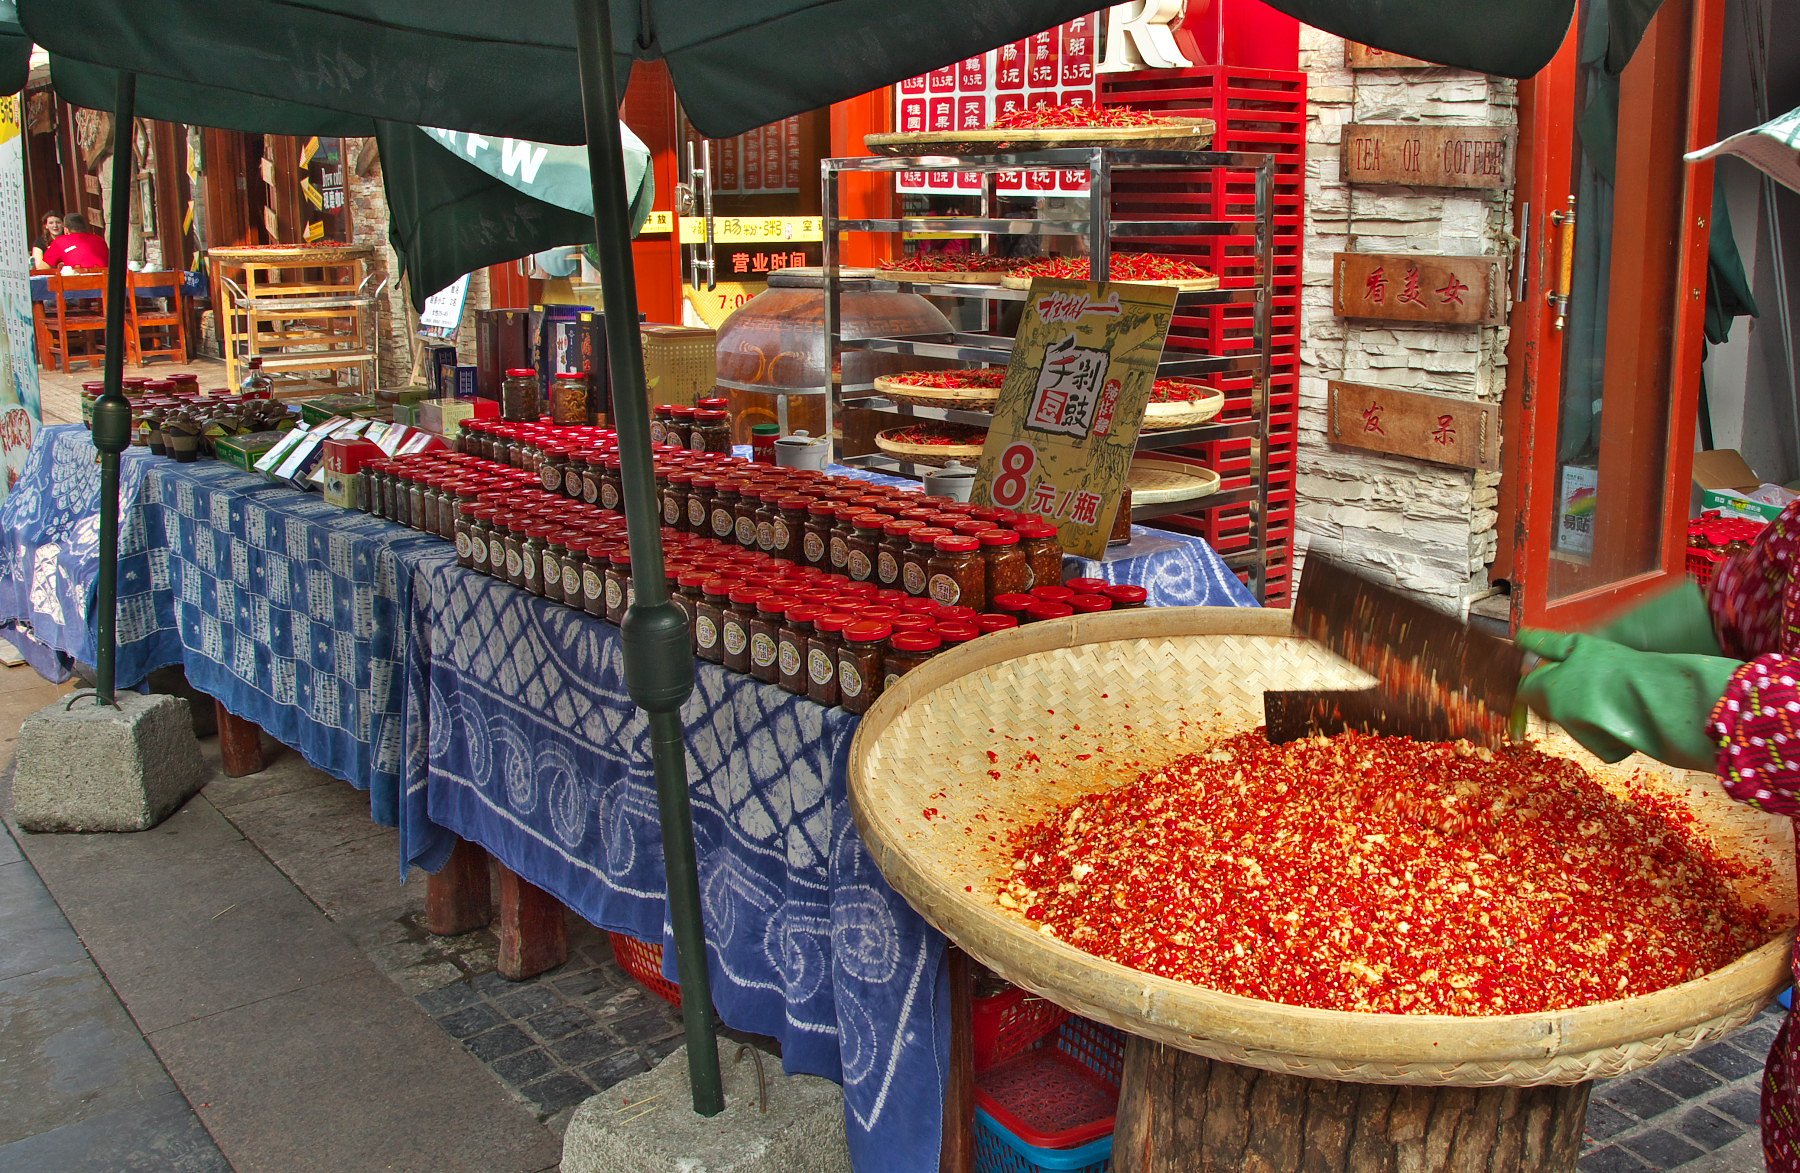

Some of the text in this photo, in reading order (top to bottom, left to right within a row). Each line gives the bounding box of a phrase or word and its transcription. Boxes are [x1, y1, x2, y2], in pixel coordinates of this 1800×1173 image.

[1095, 0, 1193, 74] R
[963, 73, 983, 86] 9.5元
[1001, 68, 1020, 84] 3元
[1033, 65, 1053, 82] 5元
[1063, 63, 1092, 80] 5.5元
[903, 76, 925, 89] 13.5元
[932, 75, 954, 87] 13.5元
[906, 104, 922, 131] 桂圆
[935, 102, 950, 131] 白果
[1355, 138, 1504, 175] TEA OR COFFEE
[1065, 170, 1087, 184] 8元
[732, 251, 806, 273] 营业时间
[1364, 266, 1468, 308] 看美女
